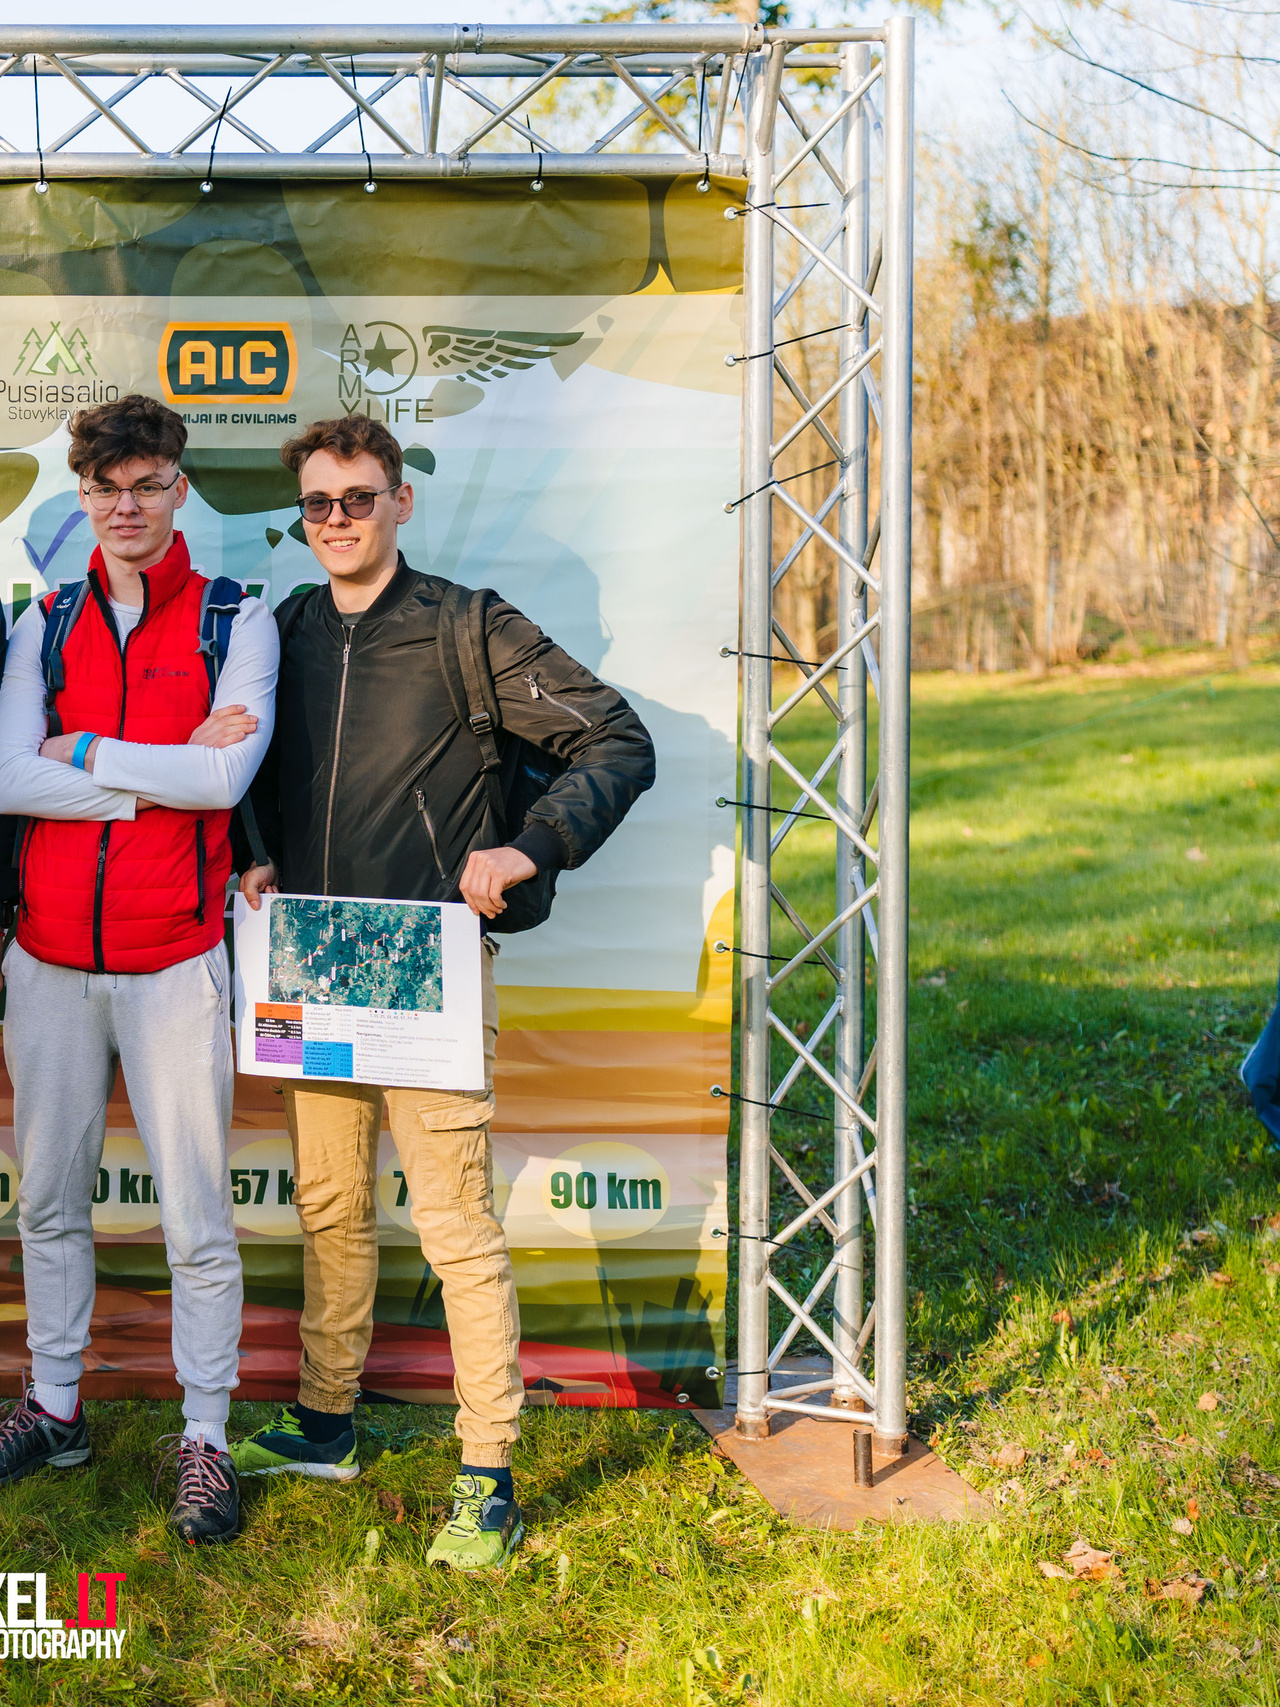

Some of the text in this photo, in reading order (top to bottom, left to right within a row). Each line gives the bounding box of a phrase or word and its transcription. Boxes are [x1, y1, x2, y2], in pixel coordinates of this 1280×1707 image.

[179, 341, 277, 385] AIC
[8, 406, 79, 423] Stovyklav
[215, 413, 228, 424] IR
[231, 413, 297, 424] CIVILIAMS
[366, 398, 434, 423] LIFE
[231, 1169, 269, 1205] 57
[551, 1171, 662, 1209] 90 km
